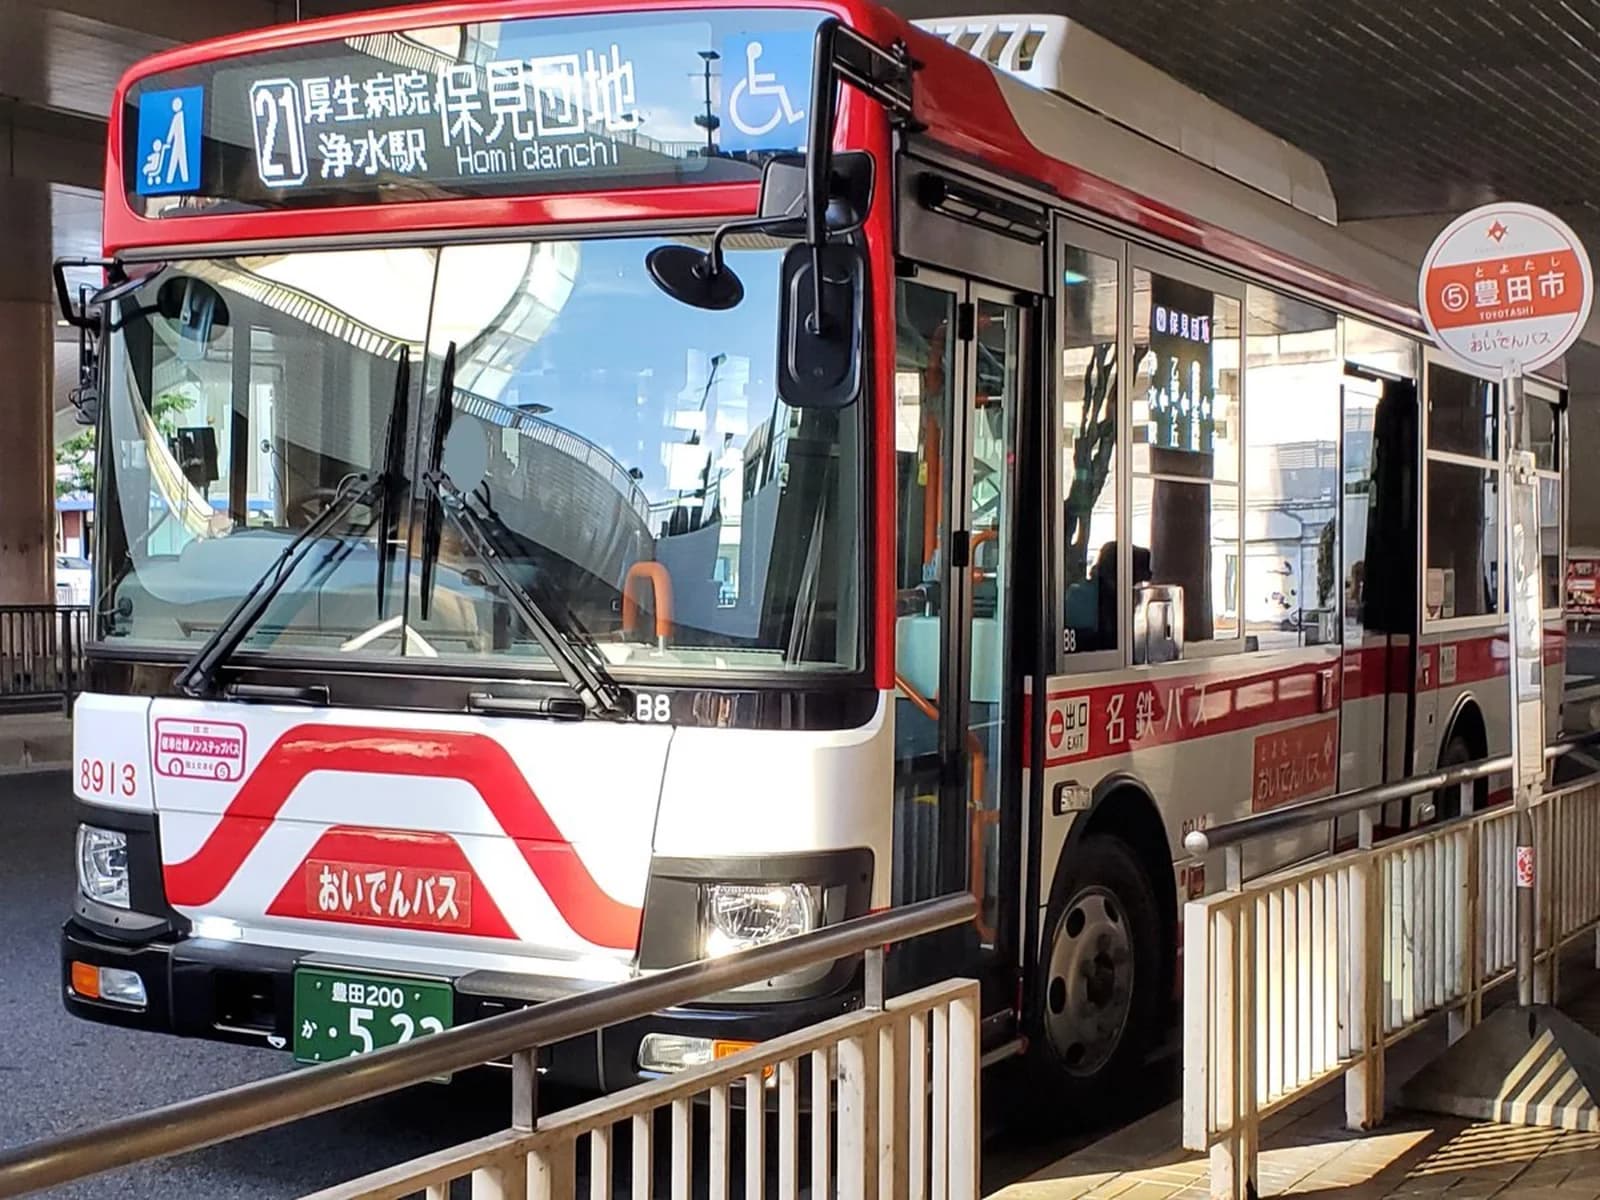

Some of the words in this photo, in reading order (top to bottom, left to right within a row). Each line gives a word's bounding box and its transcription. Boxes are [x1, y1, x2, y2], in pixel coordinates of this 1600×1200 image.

[302, 69, 431, 123] 厚生病院
[433, 44, 641, 147] 保見団地
[255, 89, 302, 176] 21
[318, 129, 428, 178] 浄水駅
[1475, 270, 1565, 308] 豊田市
[1479, 306, 1534, 320] TOYOTASHI
[1470, 331, 1550, 353] おいでんバス
[636, 694, 670, 722] B8
[1065, 703, 1087, 730] 出口
[1105, 683, 1208, 744] 名鉄バス
[1067, 734, 1084, 750] EXIT
[81, 758, 137, 796] 8913
[318, 865, 459, 921] おいでんバス
